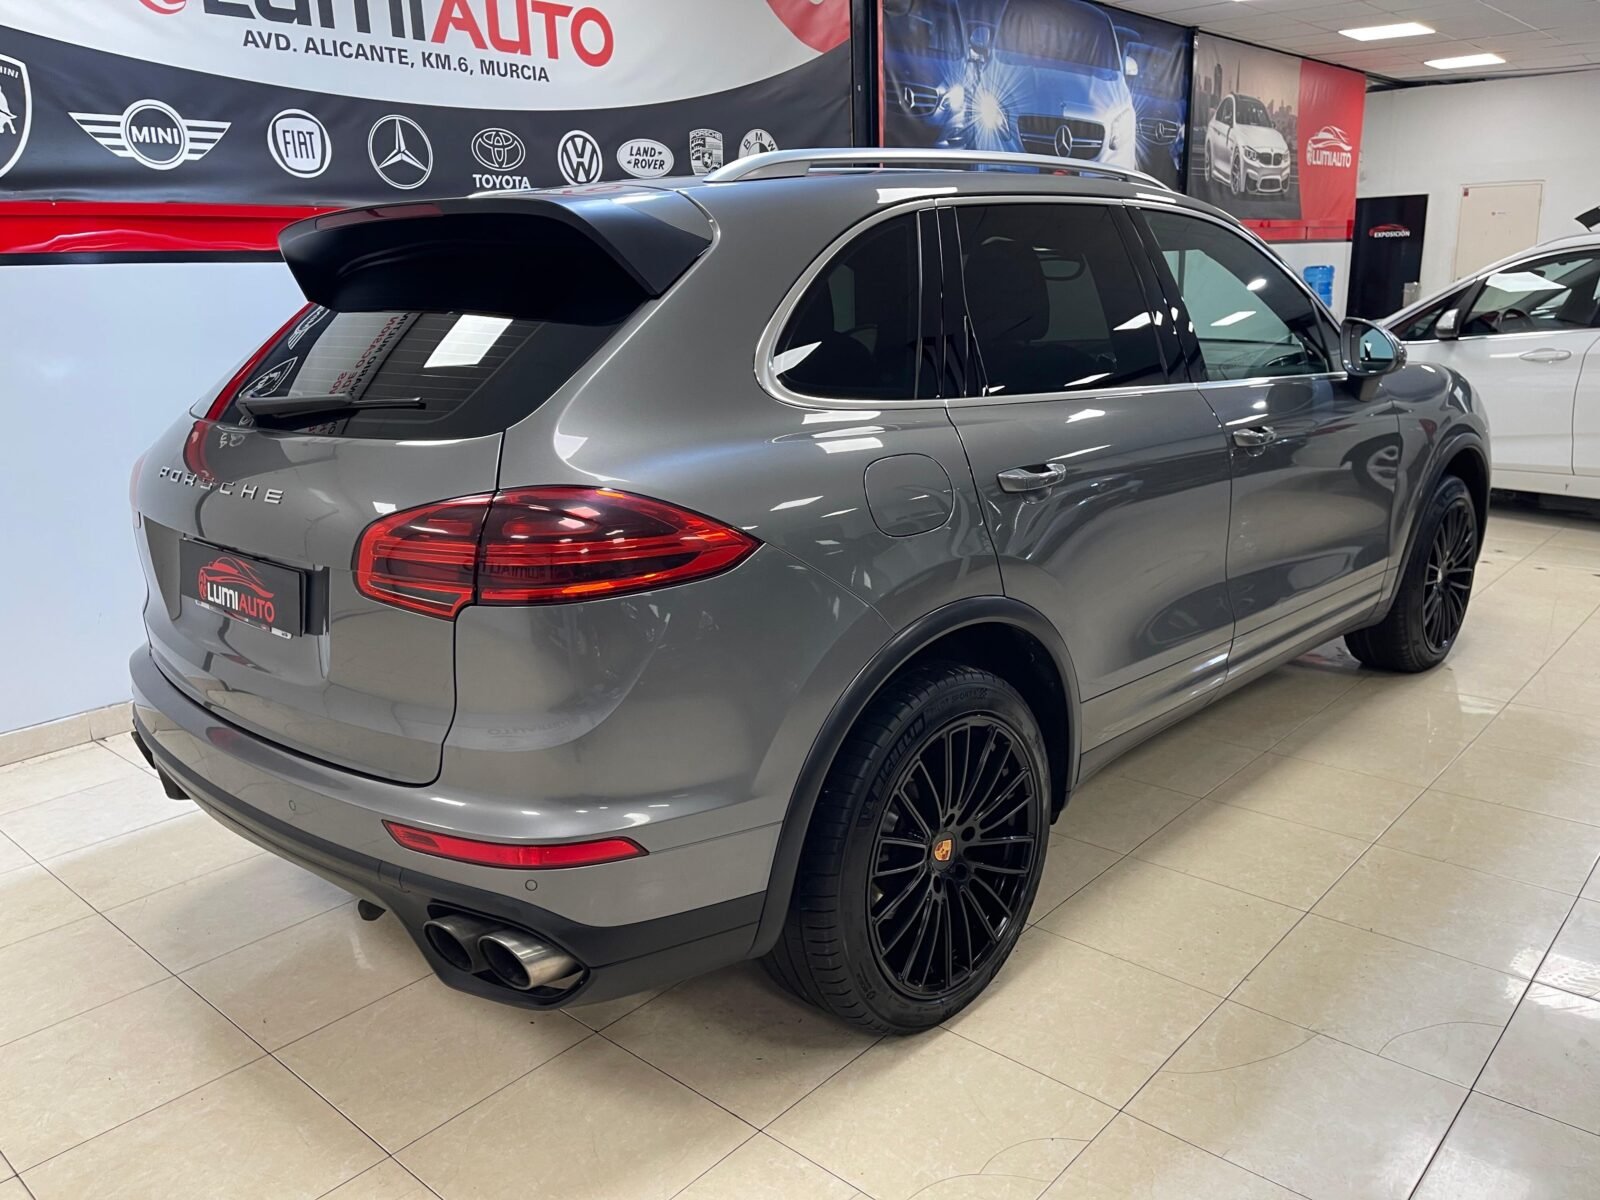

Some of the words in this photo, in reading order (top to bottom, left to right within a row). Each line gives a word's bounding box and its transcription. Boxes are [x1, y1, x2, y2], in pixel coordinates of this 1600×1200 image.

[243, 29, 298, 53] AVD.
[304, 37, 415, 68] ALICANTE,
[421, 51, 474, 76] KM.6,
[480, 58, 550, 83] MURCIA
[130, 124, 180, 145] MINI
[690, 129, 722, 141] PORSCHE
[282, 129, 316, 160] FIAT
[629, 145, 656, 158] LAND
[632, 158, 665, 171] ROVER
[472, 173, 531, 189] TOYOTA
[159, 466, 284, 504] PORSCHE
